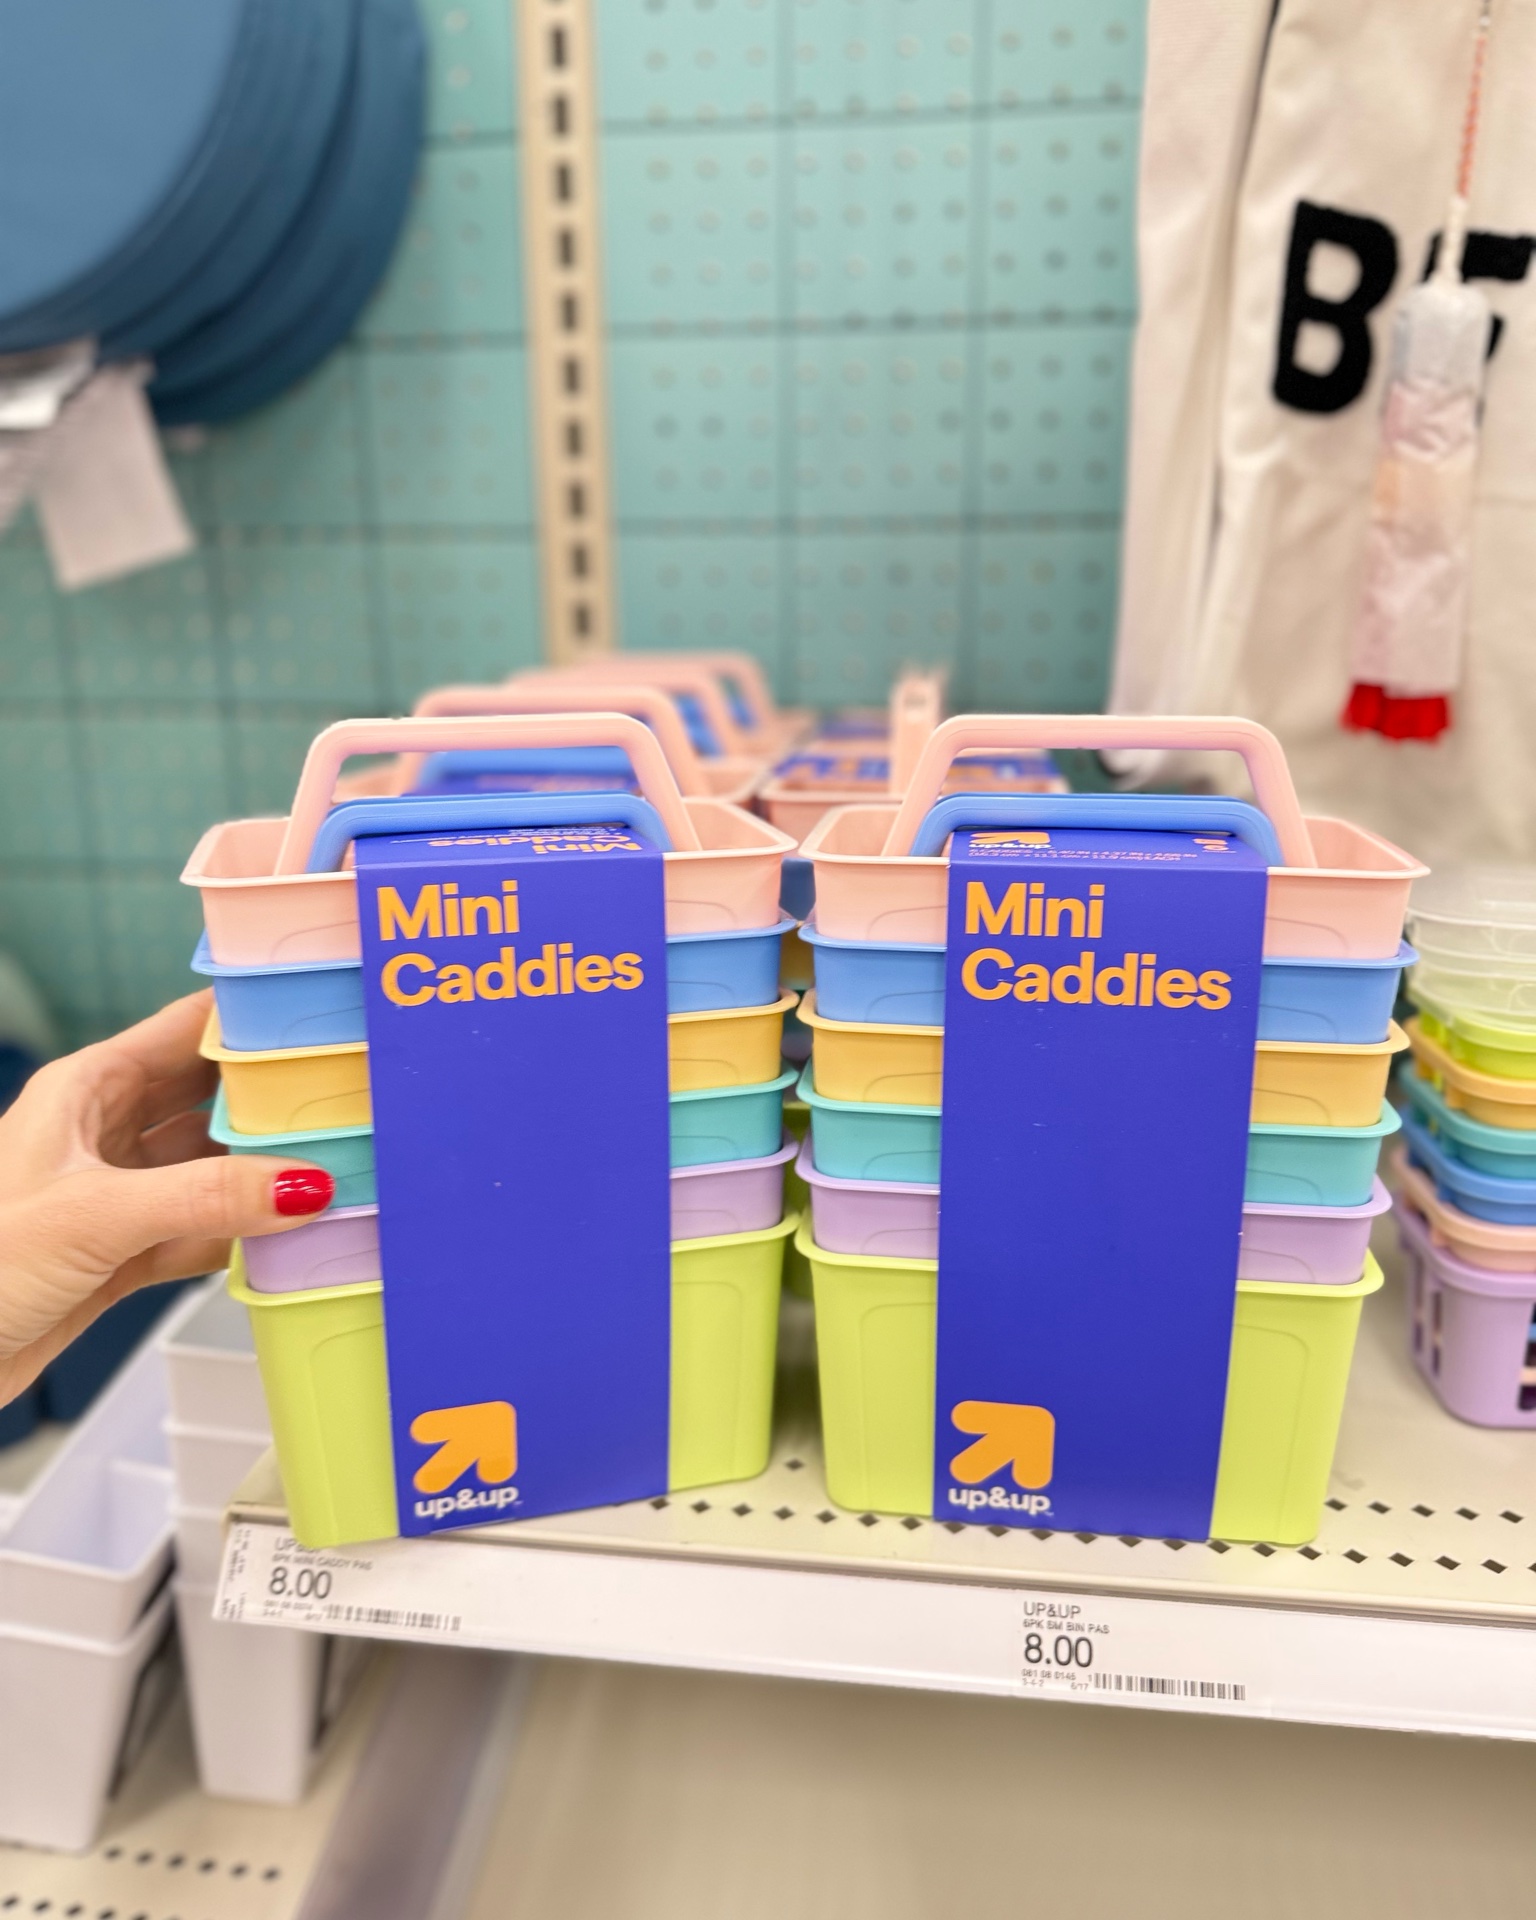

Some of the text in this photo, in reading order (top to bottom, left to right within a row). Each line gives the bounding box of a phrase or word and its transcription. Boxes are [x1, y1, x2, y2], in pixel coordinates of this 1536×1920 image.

[428, 835, 631, 847] Caddies
[532, 842, 643, 855] Mini
[376, 879, 520, 941] Mini
[965, 881, 1106, 939] Mini
[380, 942, 645, 1007] Caddies
[961, 948, 1232, 1010] Caddies
[414, 1486, 519, 1519] up&up
[948, 1486, 1052, 1516] up&up
[269, 1566, 332, 1600] 8.00
[1023, 1601, 1082, 1619] UP&UP
[1023, 1618, 1110, 1634] 6PK SM BIN PAS
[1024, 1632, 1093, 1668] 8.00
